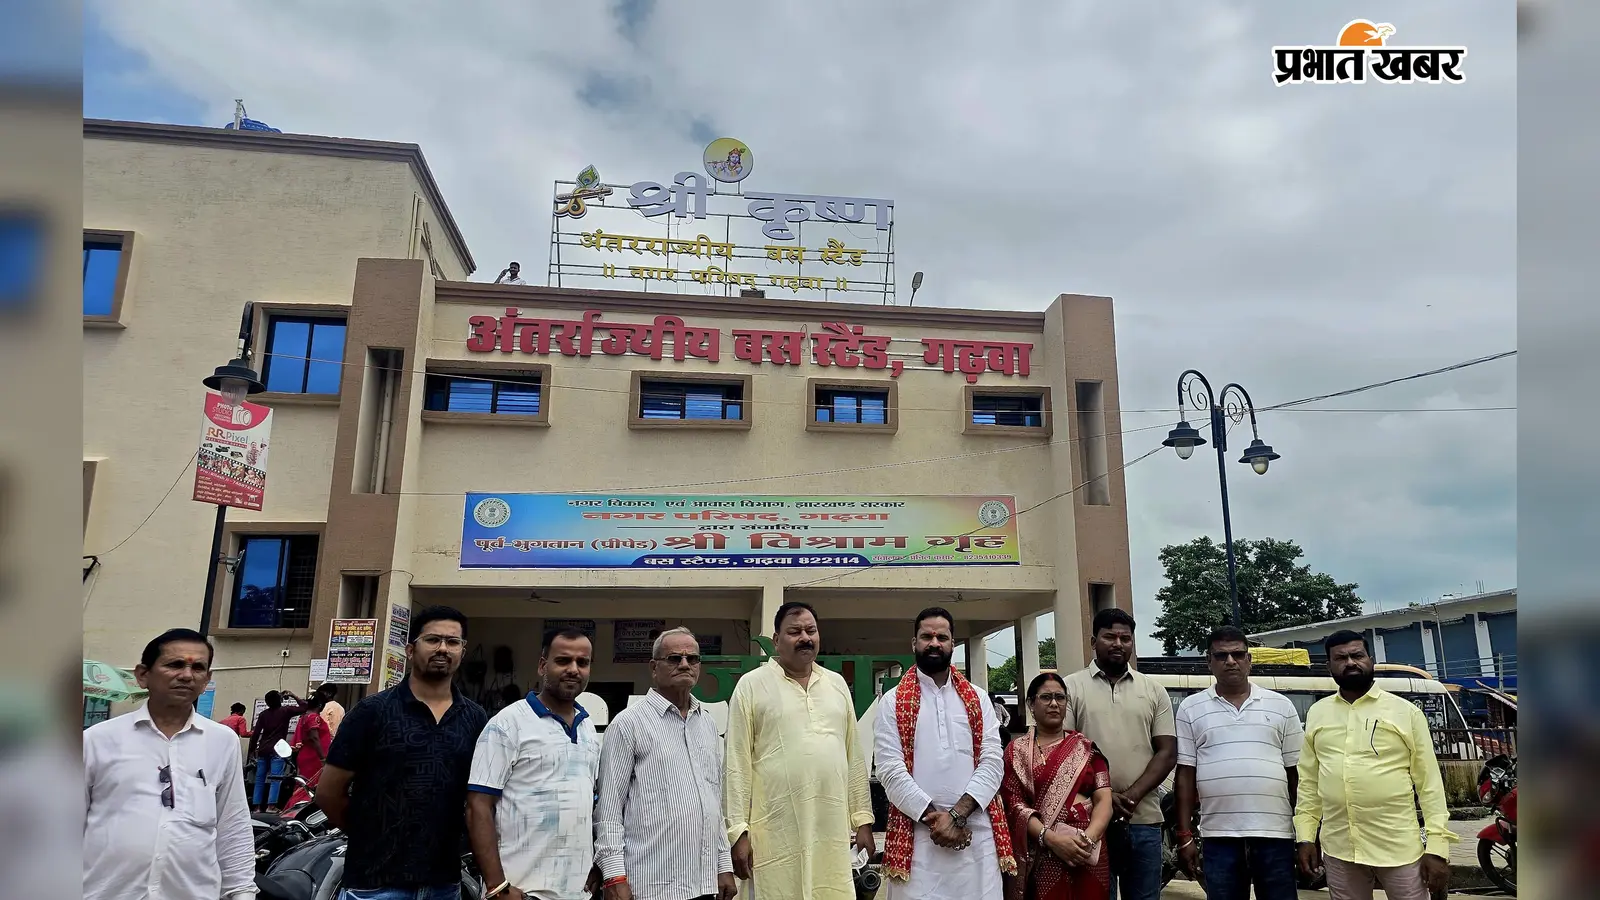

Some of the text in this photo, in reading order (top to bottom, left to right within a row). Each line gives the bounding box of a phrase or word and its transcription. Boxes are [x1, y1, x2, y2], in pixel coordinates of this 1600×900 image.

[626, 171, 894, 240] श्री कृष्ण
[580, 228, 867, 266] अंतरराज्यीय बस स्टैंड
[629, 266, 678, 282] नगर
[769, 274, 824, 293] गढ़वा
[466, 308, 1034, 383] अंतर्राज्यीय बस स्टैंड, गढ़वा
[206, 426, 249, 445] RR Pixel
[568, 499, 603, 507] नगर
[607, 498, 656, 507] विकास
[665, 498, 686, 507] एवं
[795, 500, 856, 508] झारखण्ड
[860, 500, 905, 508] सरकार
[581, 511, 666, 520] नगर
[799, 511, 890, 523] गढ़वा
[698, 523, 809, 531] द्वारा संचालित
[474, 532, 1008, 553] पूर्व-भुगतान (प्रीपेड) श्री विश्राम गृह
[644, 557, 674, 566] बस
[743, 557, 795, 567] गढ़वा
[798, 556, 860, 565] 822114
